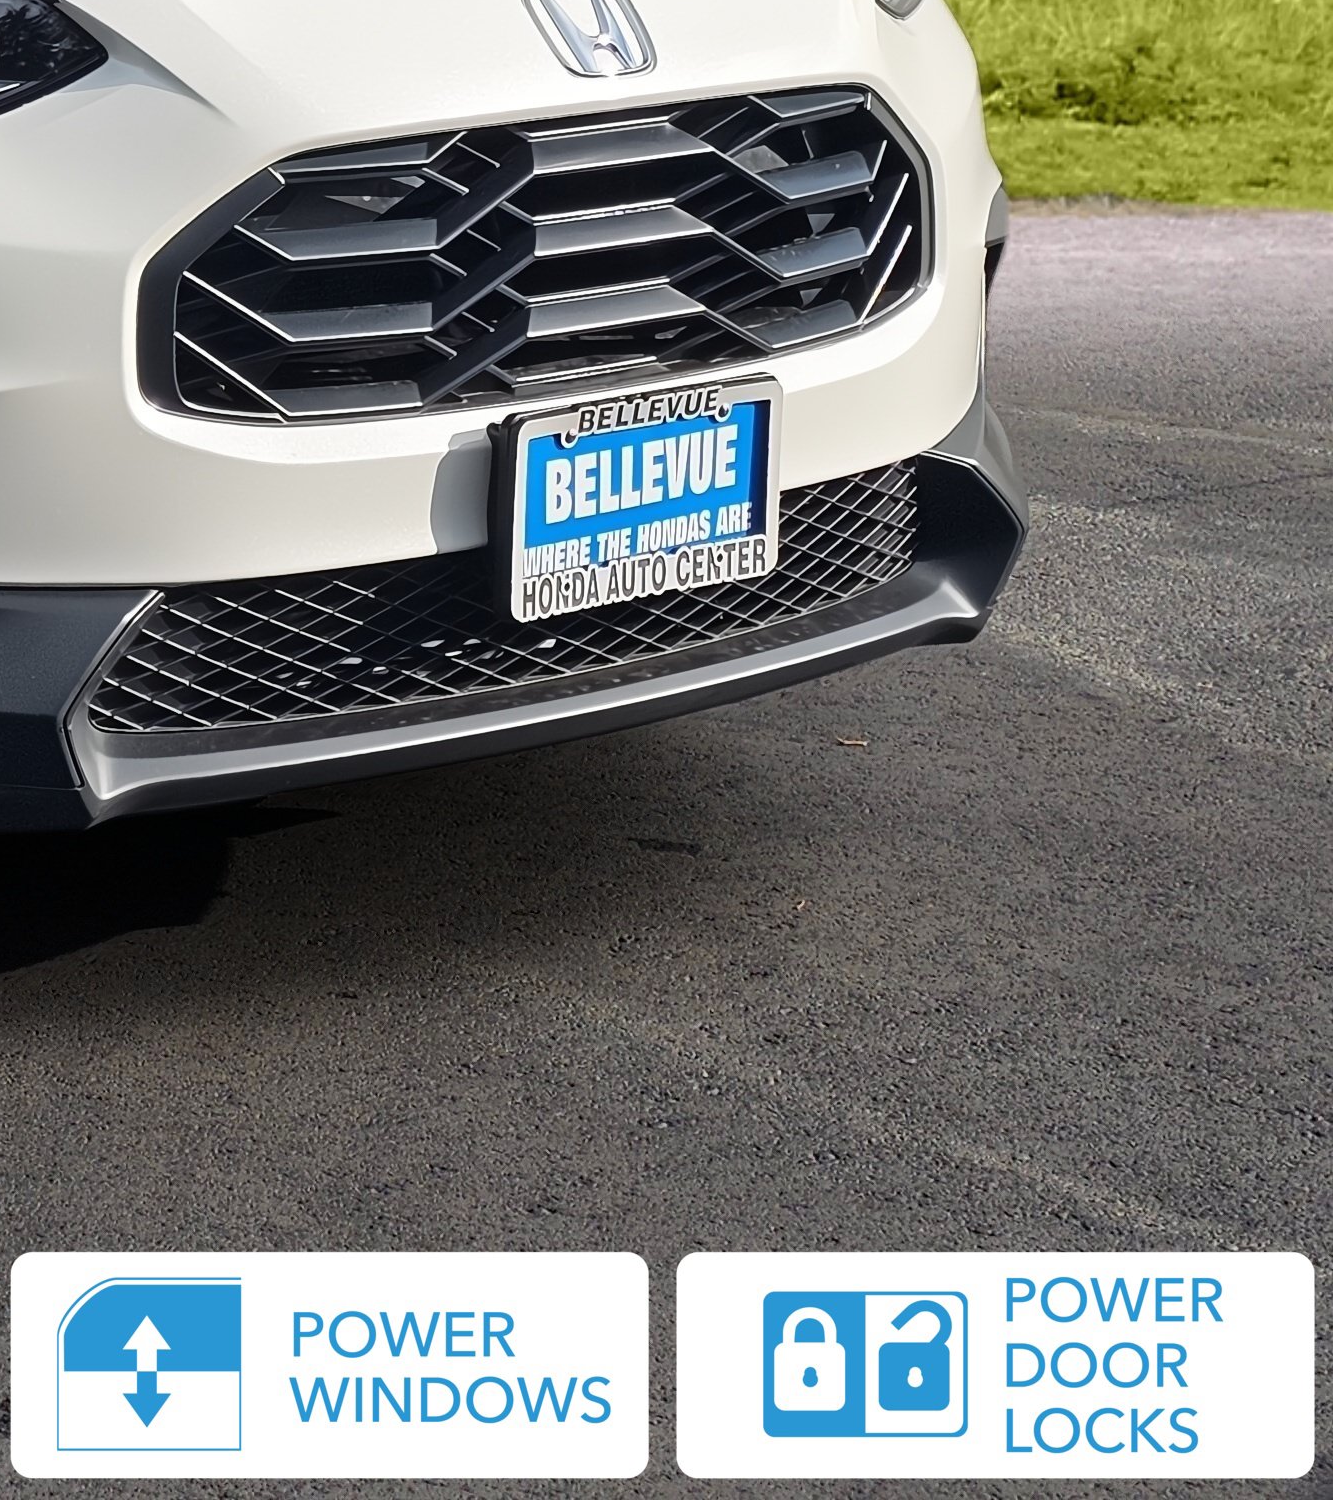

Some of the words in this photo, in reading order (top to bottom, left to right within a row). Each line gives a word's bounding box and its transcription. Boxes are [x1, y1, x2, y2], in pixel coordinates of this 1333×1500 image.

[578, 389, 720, 434] BELLEVUE
[545, 424, 738, 525] BELLEVUE
[522, 566, 600, 619] HONDA
[606, 555, 667, 601] AUTO
[675, 538, 767, 587] CENTER
[523, 535, 592, 578] WHERE
[596, 527, 632, 563] THE
[636, 509, 712, 555] HONDAS
[715, 501, 752, 537] ARE
